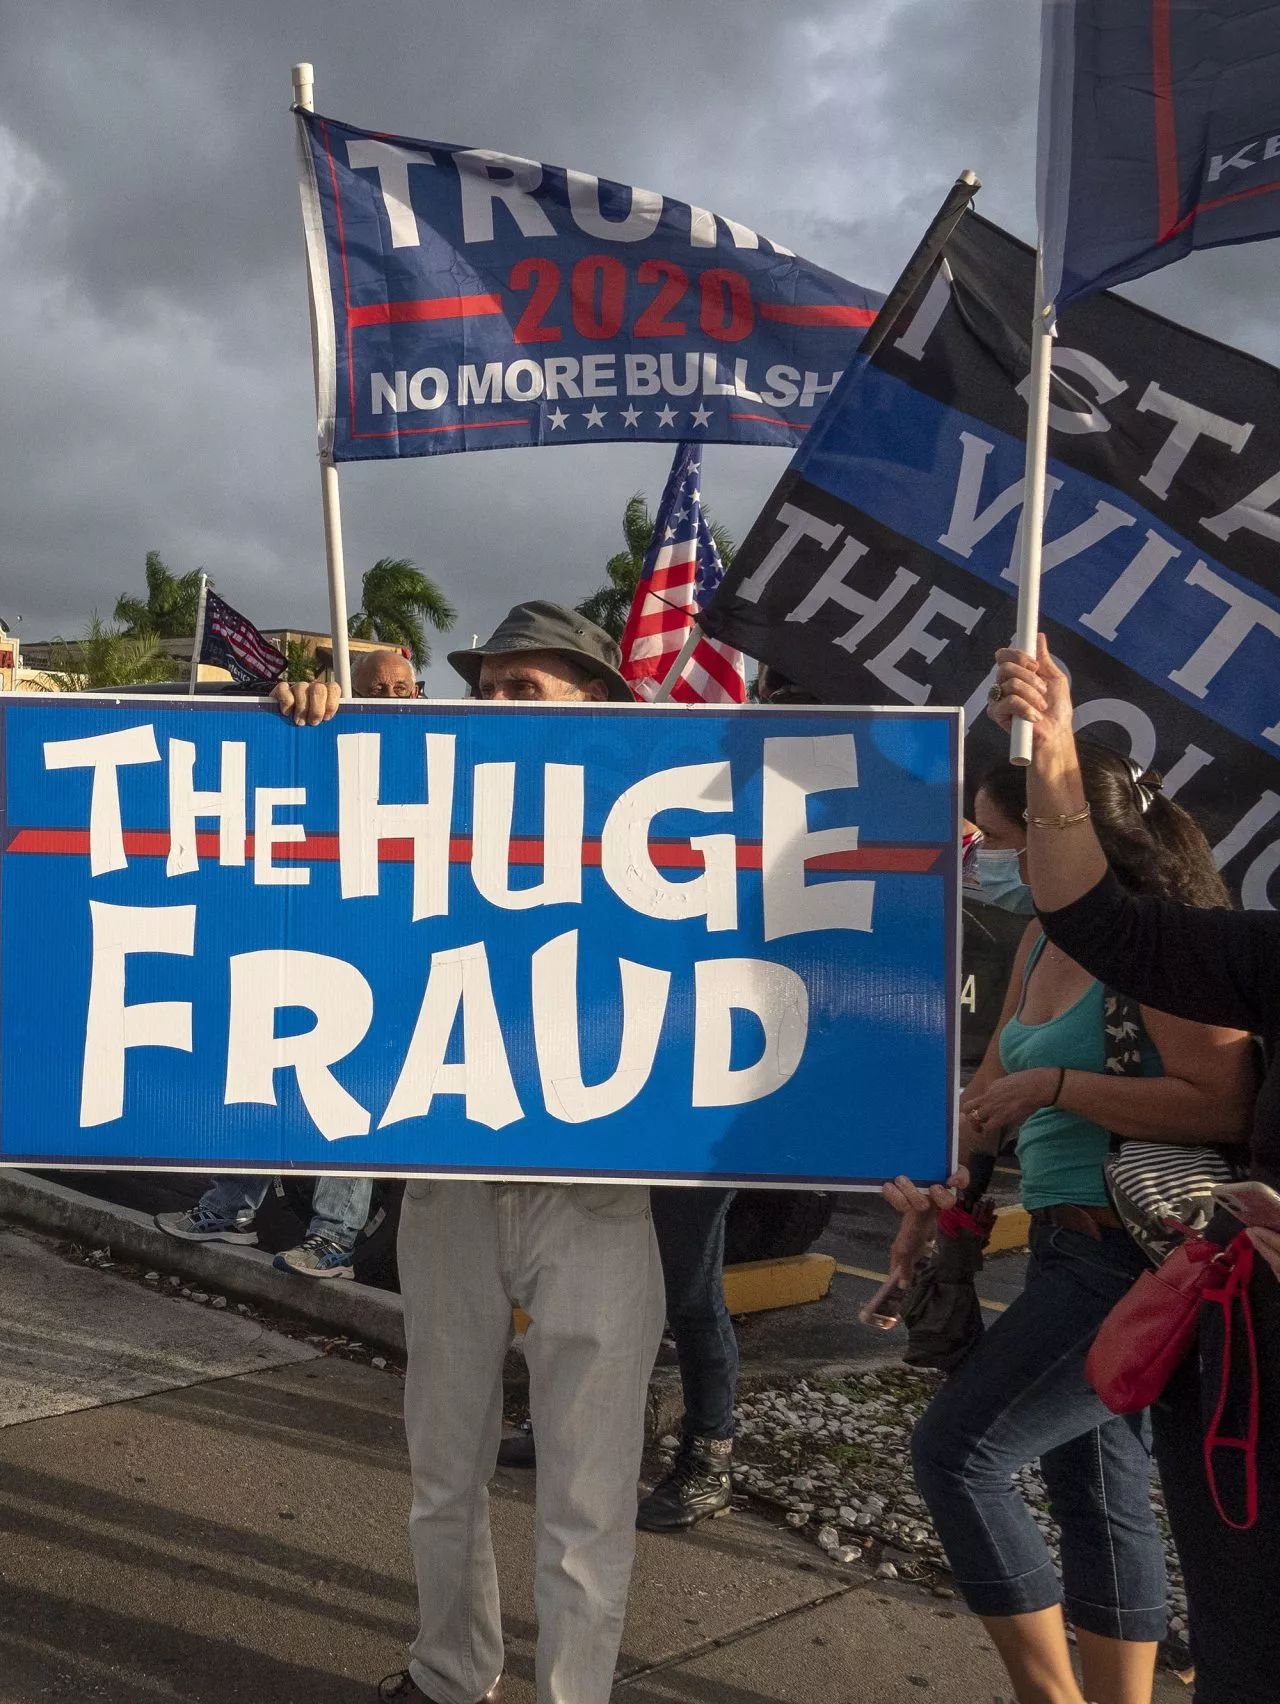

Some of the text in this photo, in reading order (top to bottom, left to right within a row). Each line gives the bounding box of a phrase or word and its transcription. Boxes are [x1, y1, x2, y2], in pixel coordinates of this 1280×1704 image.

[370, 367, 449, 415] NO
[458, 354, 618, 407] MORE
[509, 254, 755, 343] 2020
[736, 503, 985, 706] THE
[939, 431, 1280, 748] WIT
[44, 725, 310, 887] THE
[337, 733, 876, 943] HUGE
[80, 901, 810, 1142] FRAUD
